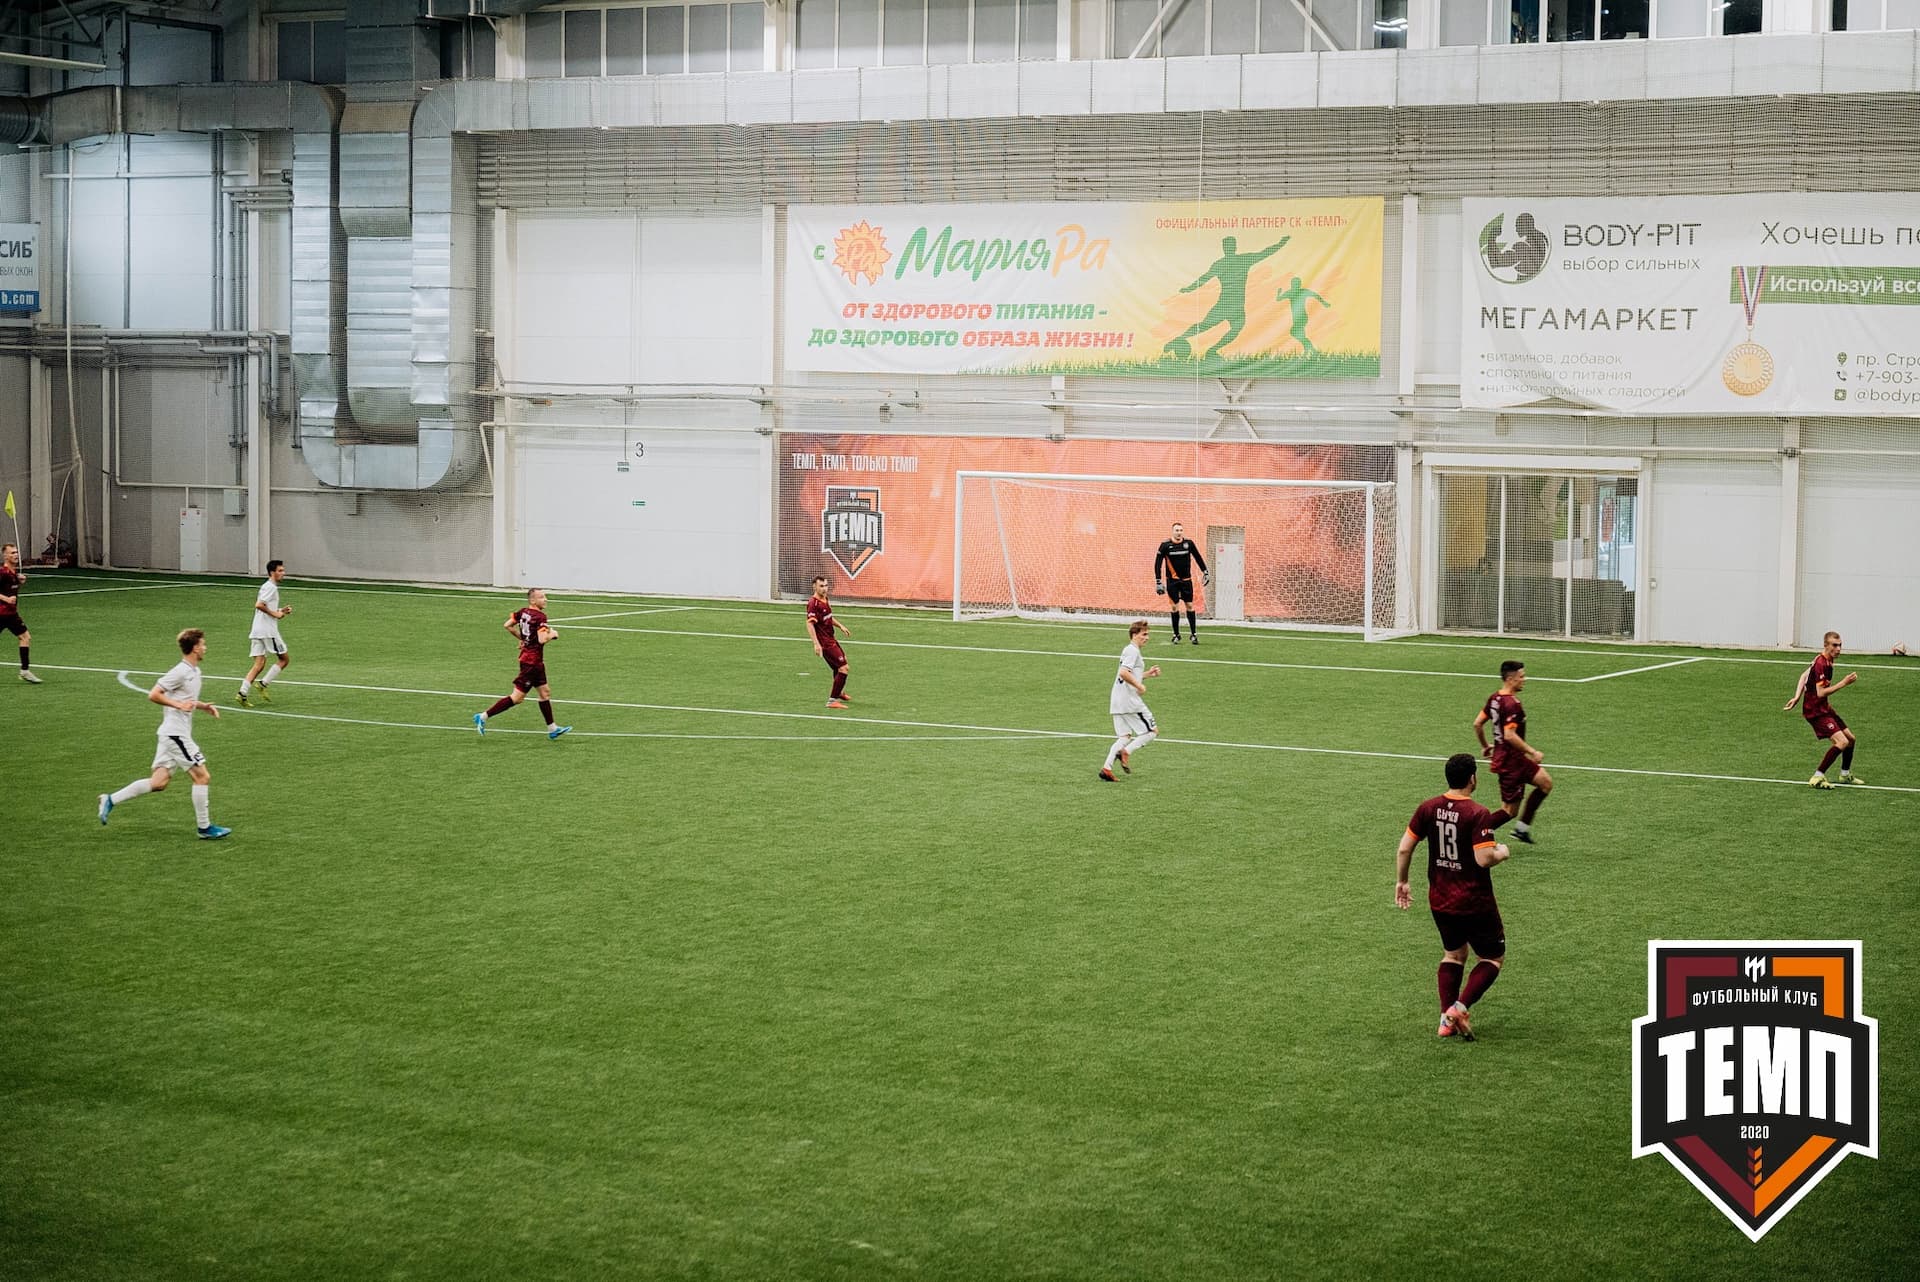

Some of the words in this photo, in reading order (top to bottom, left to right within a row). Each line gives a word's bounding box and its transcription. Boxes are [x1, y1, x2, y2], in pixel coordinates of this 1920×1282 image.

[1156, 216, 1239, 231] ОФИЦИАЛЬНЫЙ
[1242, 216, 1286, 229] ПАРТНЕР
[1289, 217, 1301, 228] СК
[1305, 215, 1348, 228] «ТЕМП»
[1563, 223, 1702, 247] BODY-PIT
[1760, 221, 1885, 245] Хочешь
[1896, 227, 1920, 246] п
[1562, 256, 1620, 273] выбор
[1625, 257, 1702, 271] сильных
[1770, 275, 1885, 296] Используй
[1892, 279, 1920, 293] вс
[842, 302, 868, 320] ОТ
[871, 302, 993, 322] ЗДОРОВОГО
[1480, 306, 1699, 331] МЕГАМАРКЕТ
[807, 328, 837, 347] ДО
[839, 328, 959, 348] ЗДОРОВОГО
[962, 330, 1040, 348] ОБРАЗА
[1560, 353, 1624, 366] добавок
[1856, 354, 1880, 368] пр.
[1572, 370, 1633, 381] питания
[1607, 384, 1688, 399] сладостей
[635, 441, 644, 458] 3
[792, 452, 818, 471] ТЕМП,
[822, 454, 849, 472] ТЕМП,
[852, 455, 888, 472] ТОЛЬКО
[891, 455, 918, 473] ТЕМП!
[827, 511, 879, 546] ТЕМП
[1435, 820, 1458, 860] 13
